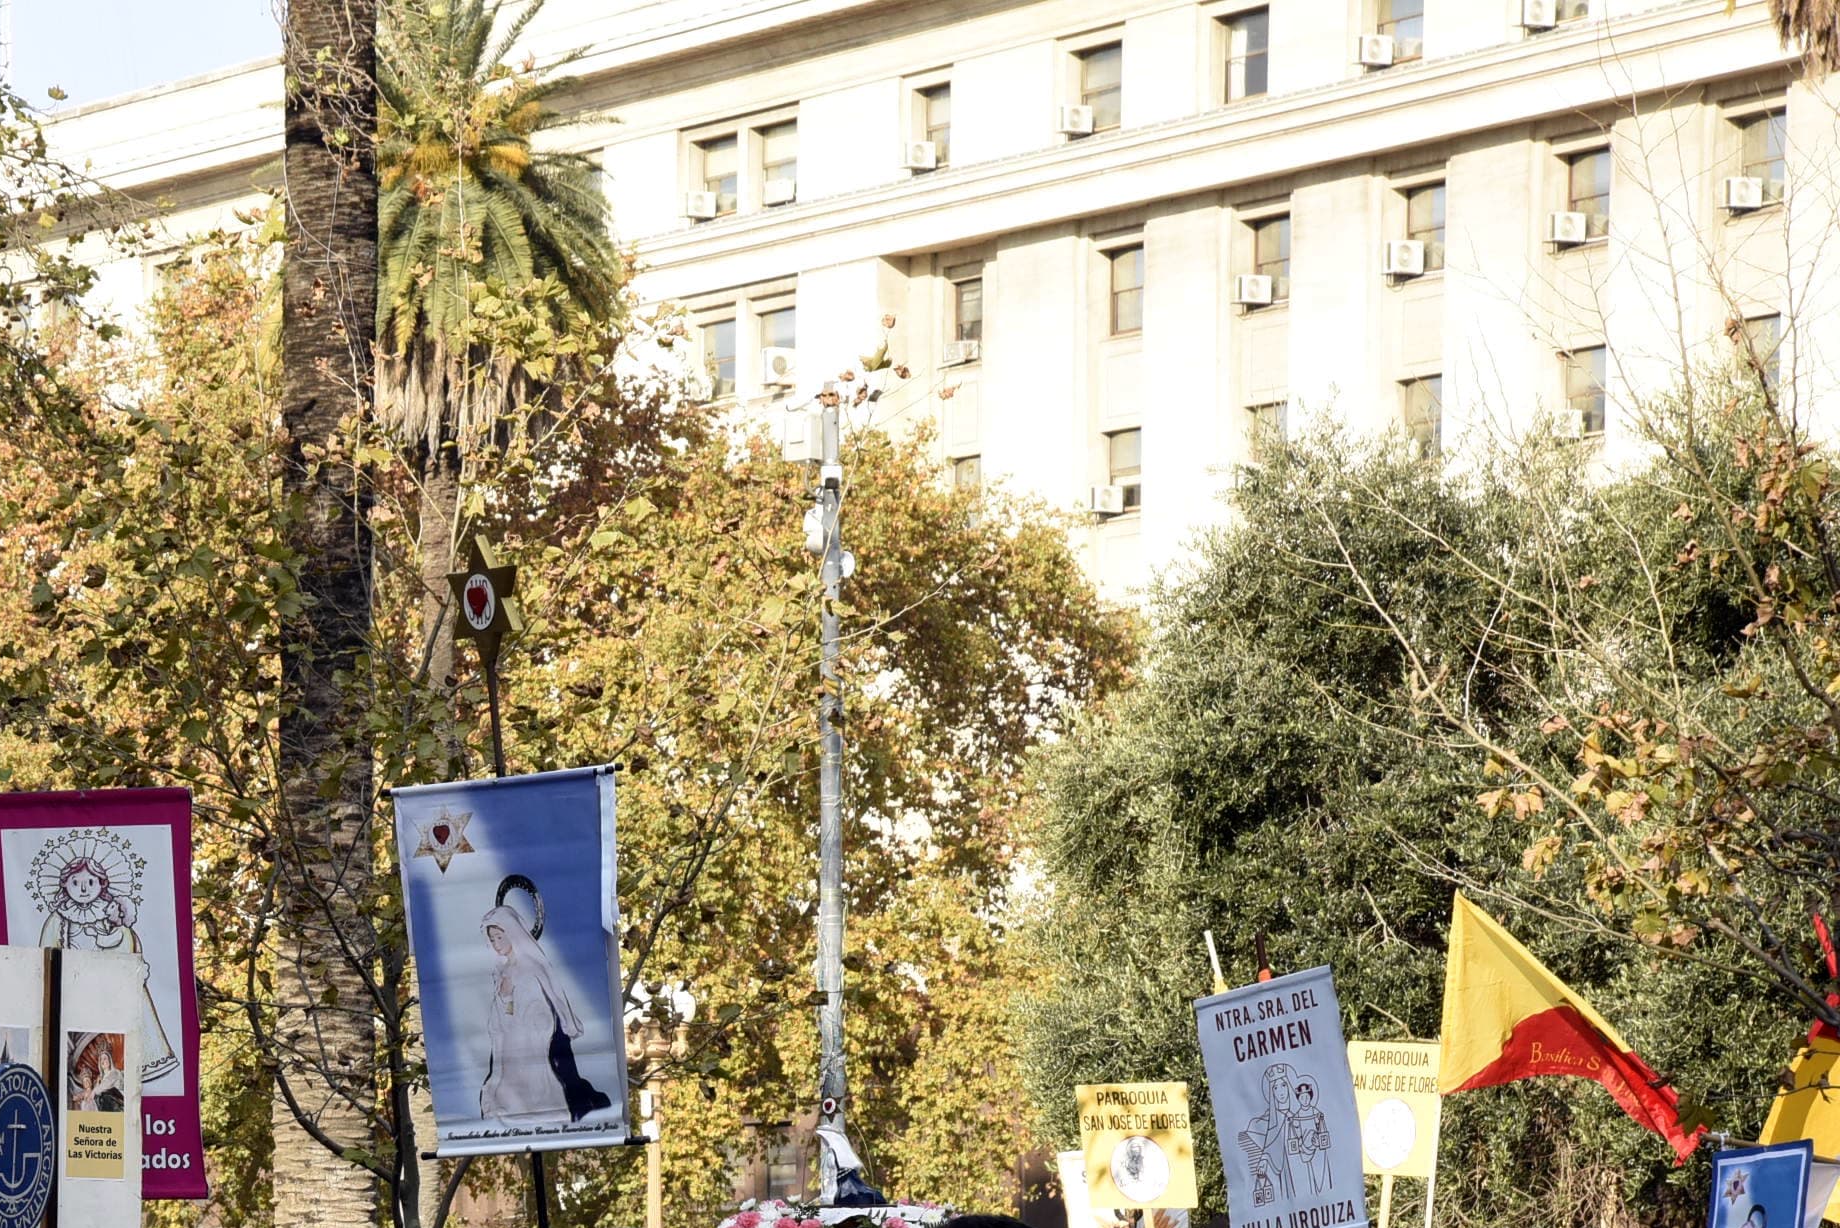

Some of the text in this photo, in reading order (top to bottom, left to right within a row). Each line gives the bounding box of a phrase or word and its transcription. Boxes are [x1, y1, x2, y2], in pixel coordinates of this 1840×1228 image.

[1215, 989, 1318, 1032] NTRA. SRA. DEL
[1233, 1019, 1313, 1063] CARMEN
[1365, 1049, 1429, 1067] PARROQUIA
[1354, 1074, 1367, 1091] AN
[1369, 1070, 1393, 1091] JOSÉ
[1395, 1075, 1407, 1092] DE
[1096, 1090, 1169, 1106] PARROQUIA
[78, 1124, 112, 1134] Nuestra
[145, 1114, 176, 1135] los
[1084, 1110, 1188, 1131] SAN JOSÉ DE FLORES
[73, 1136, 117, 1147] Señora de
[68, 1149, 123, 1160] Las Victorias
[142, 1147, 191, 1169] ados
